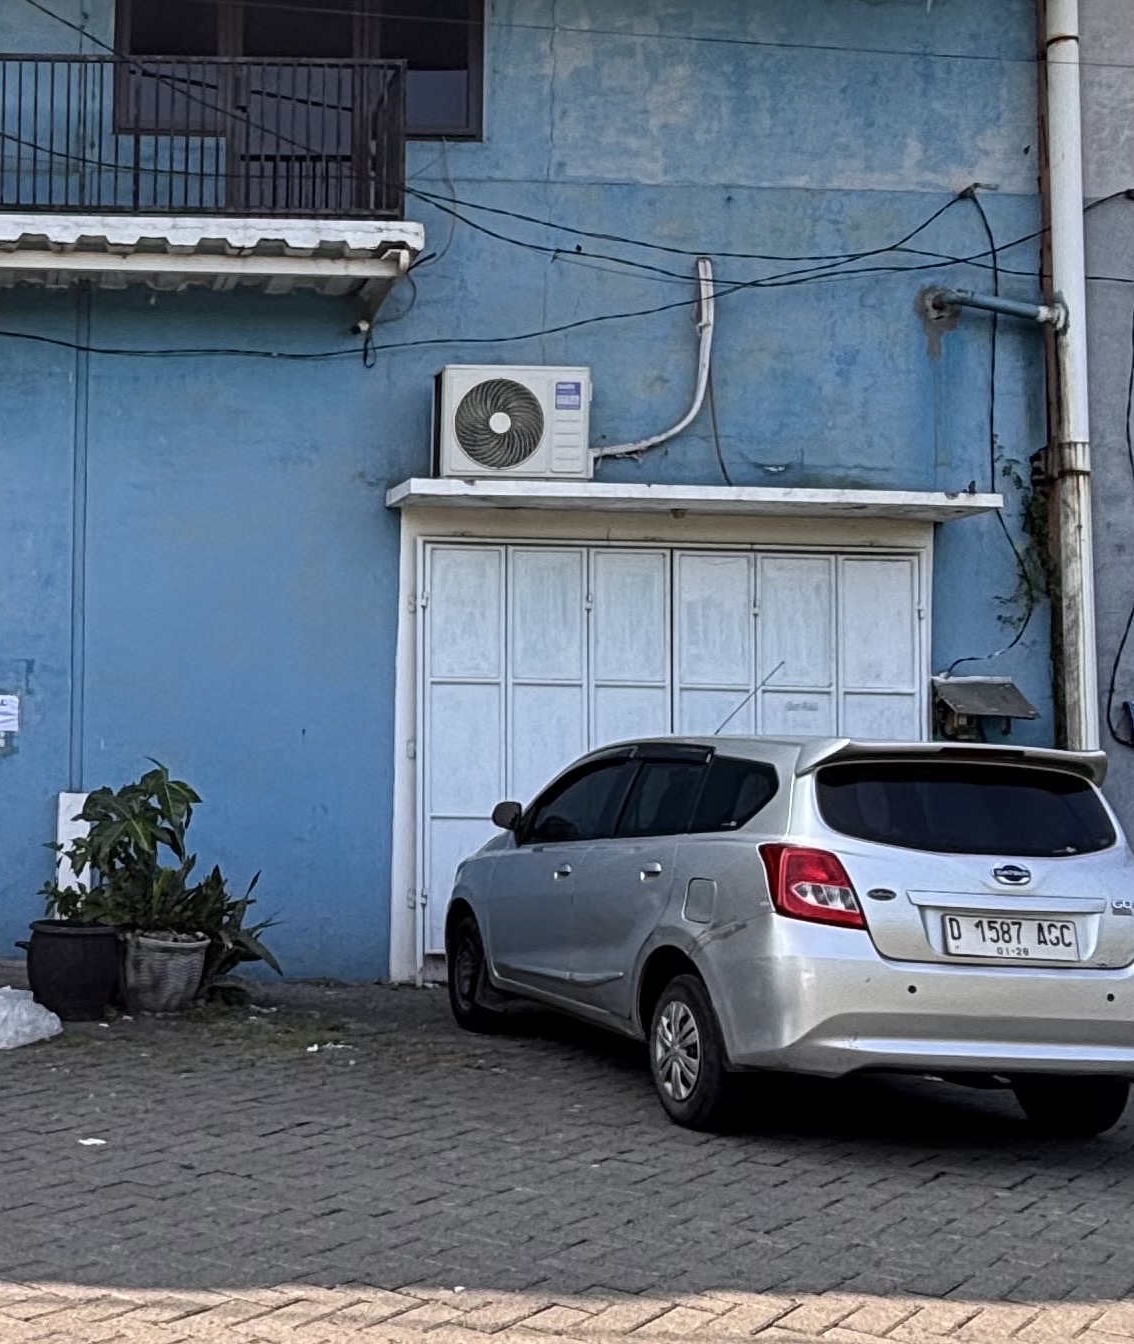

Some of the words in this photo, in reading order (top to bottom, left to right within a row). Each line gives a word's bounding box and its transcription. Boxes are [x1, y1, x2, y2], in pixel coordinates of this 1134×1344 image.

[948, 917, 962, 940] D
[974, 919, 1022, 944] 1587
[1037, 922, 1072, 947] AGC
